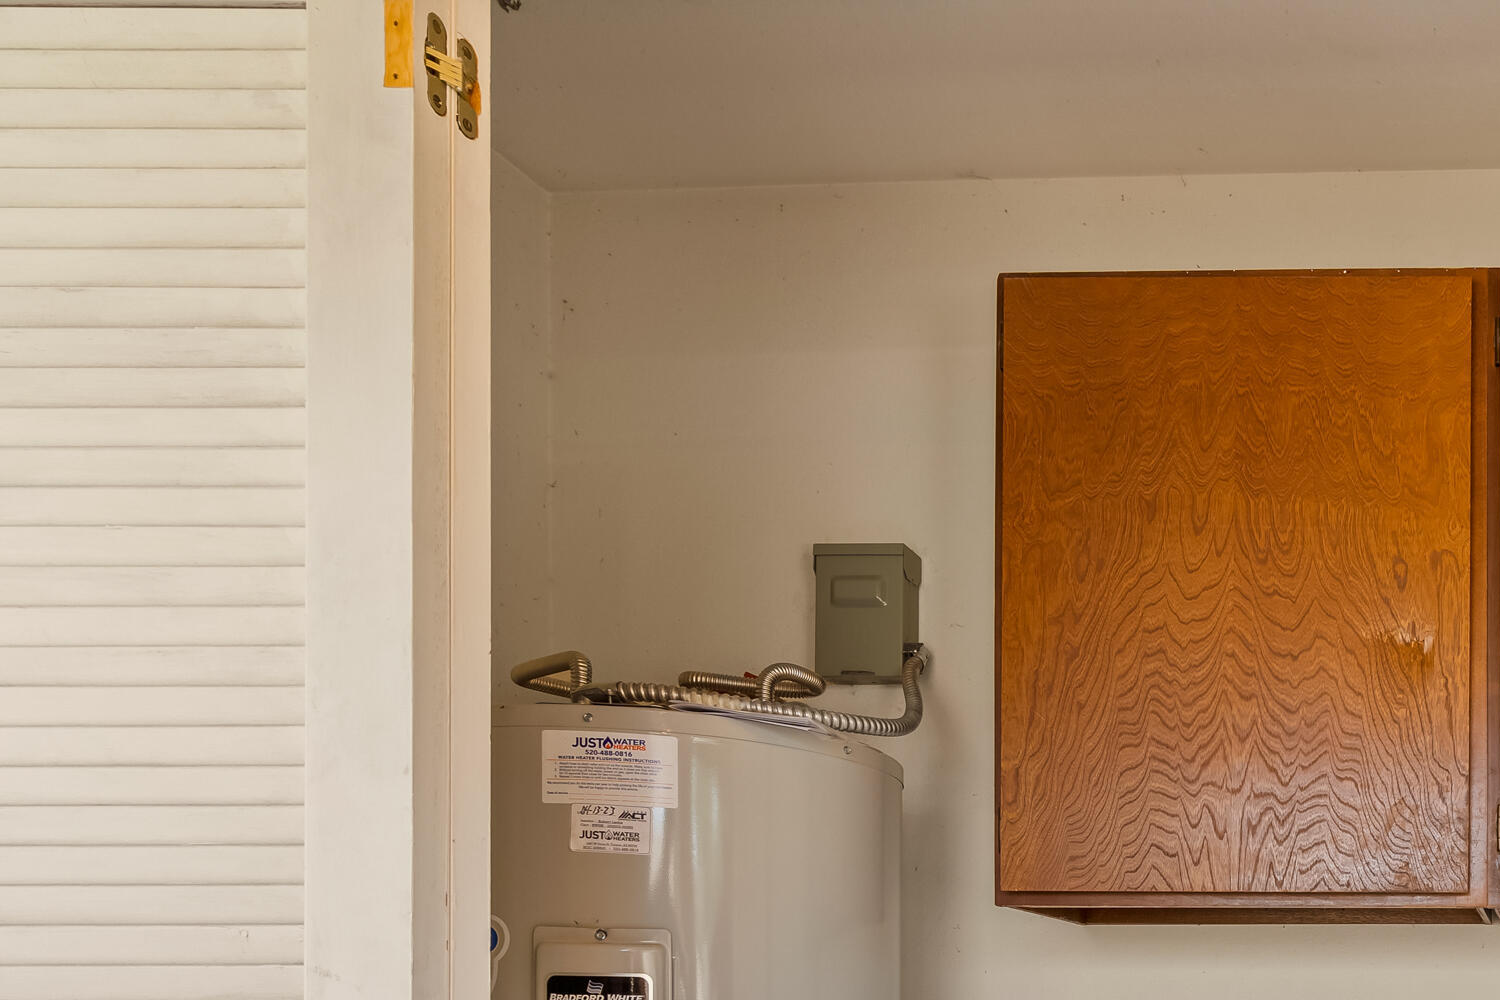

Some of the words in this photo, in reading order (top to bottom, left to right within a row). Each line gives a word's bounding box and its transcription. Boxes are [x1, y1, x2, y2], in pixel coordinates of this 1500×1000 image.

[572, 737, 604, 748] JUST
[613, 738, 646, 746] WATER
[585, 749, 632, 757] 520-488-0816
[579, 830, 605, 839] JUST
